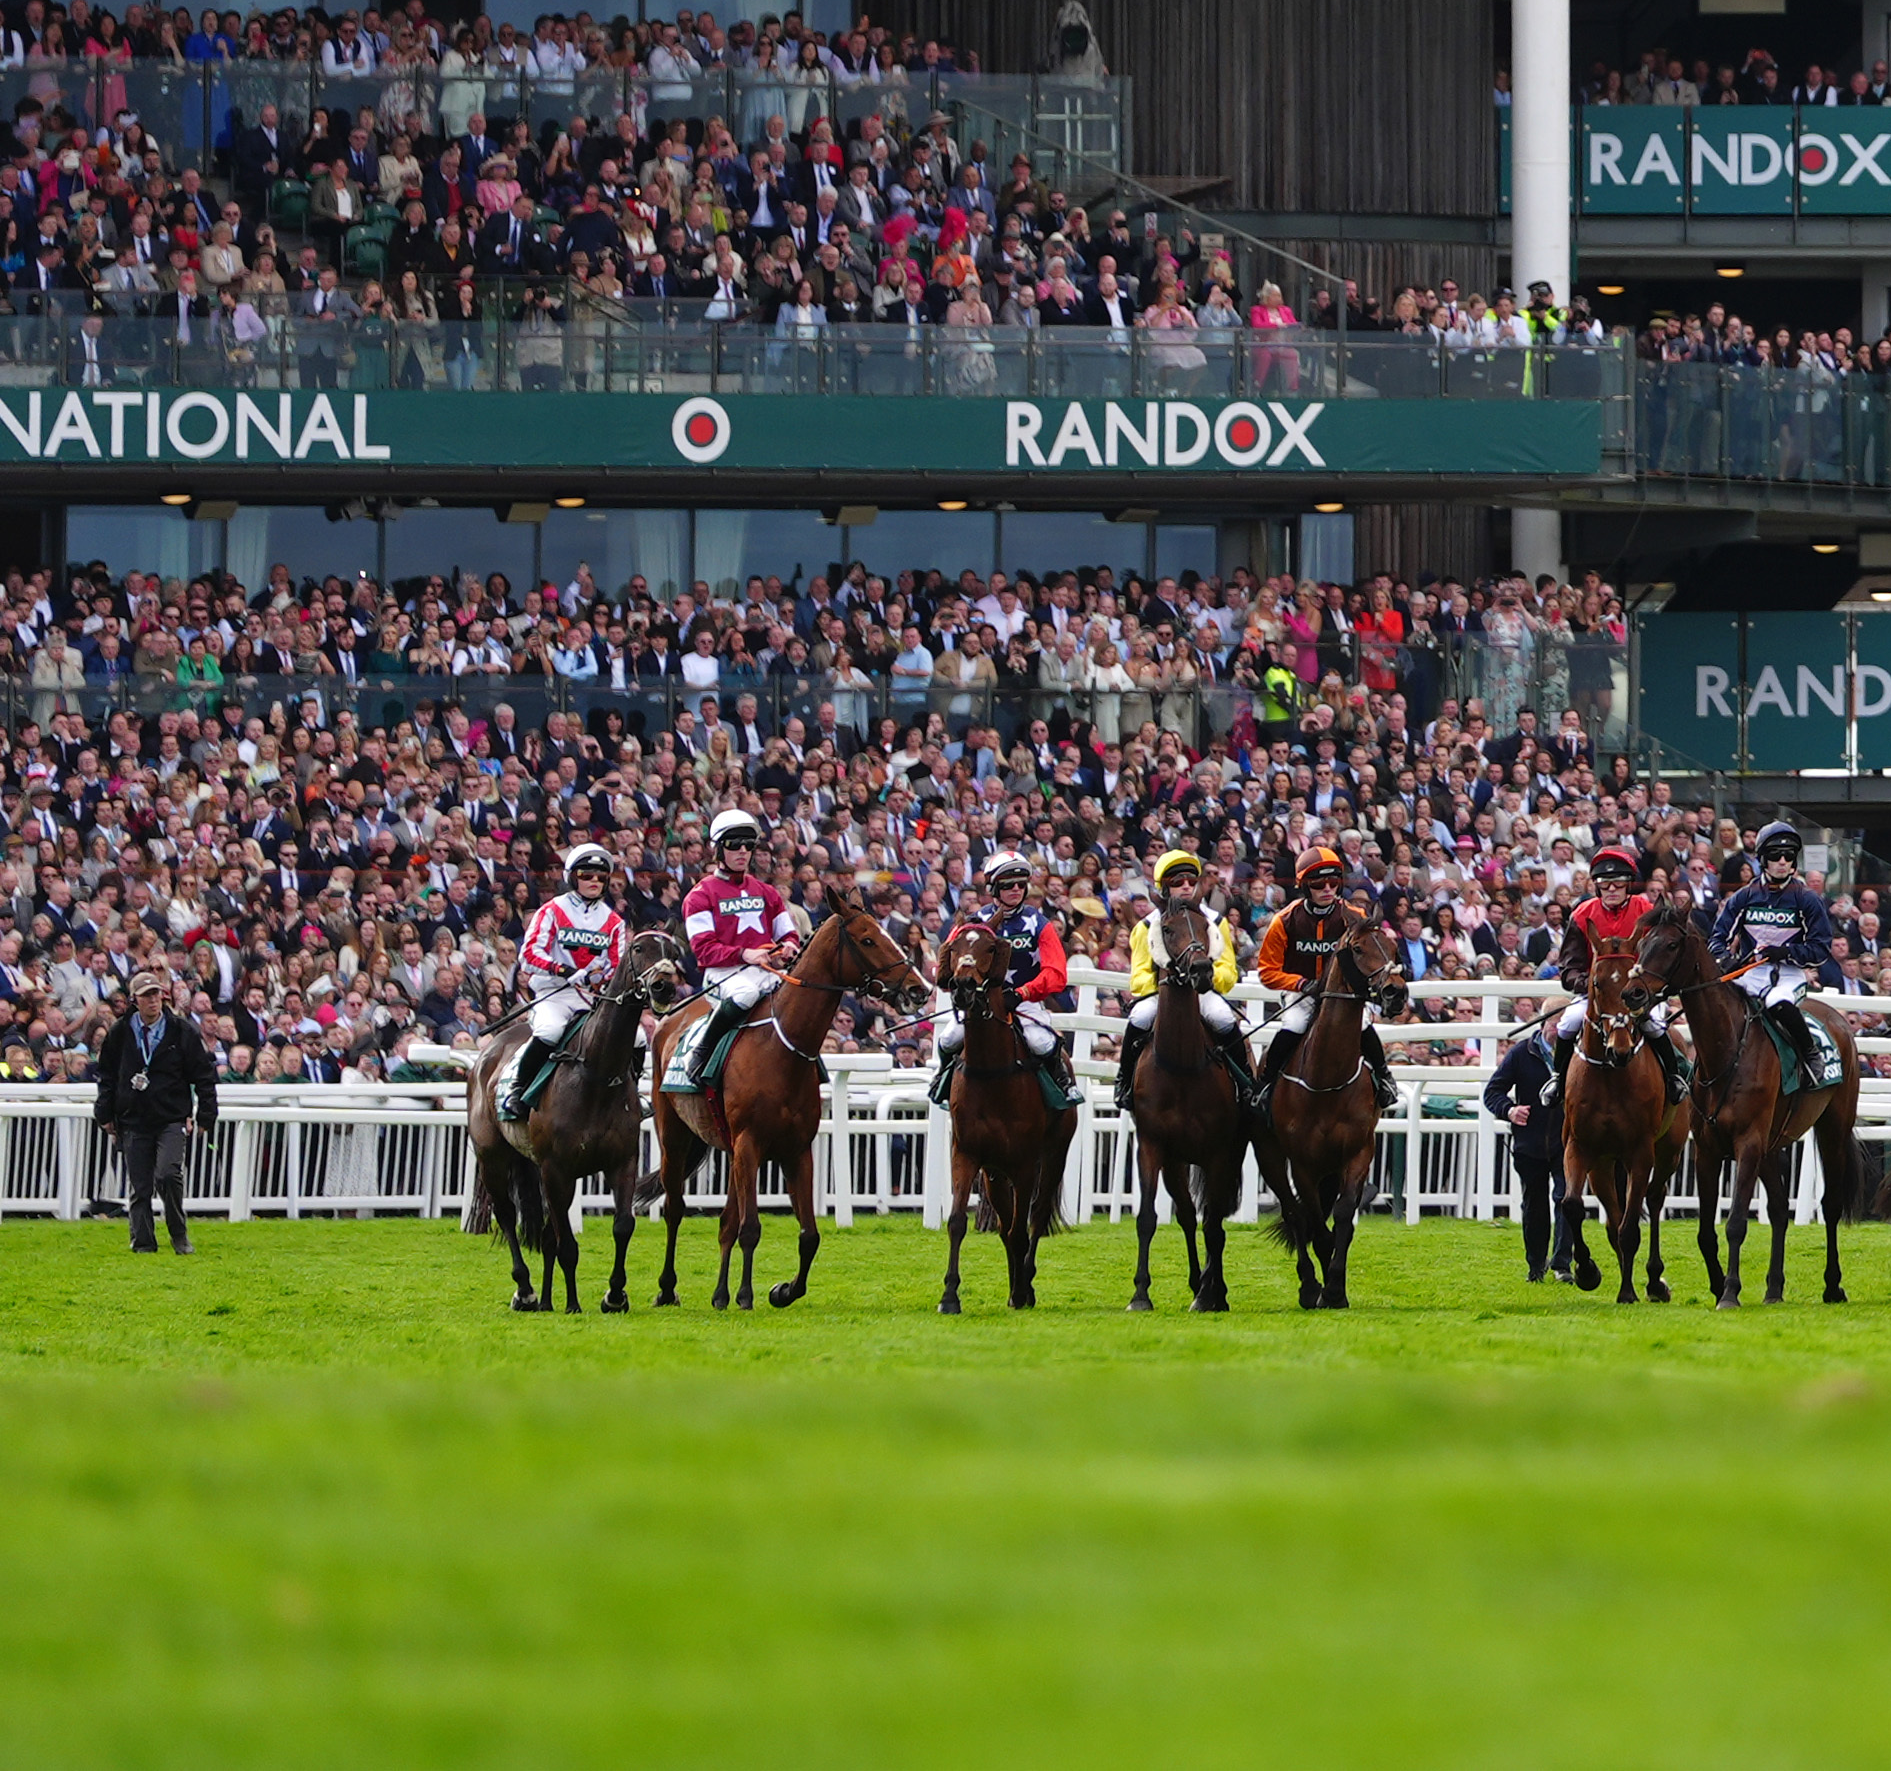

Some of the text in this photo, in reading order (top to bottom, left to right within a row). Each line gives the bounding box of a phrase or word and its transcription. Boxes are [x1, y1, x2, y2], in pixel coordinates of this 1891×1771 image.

[0, 390, 391, 460] NATIONAL
[1006, 401, 1326, 467] RANDOX
[1745, 910, 1796, 925] RANDOX
[557, 929, 611, 948] RANDOX
[1296, 940, 1339, 953] RANDO
